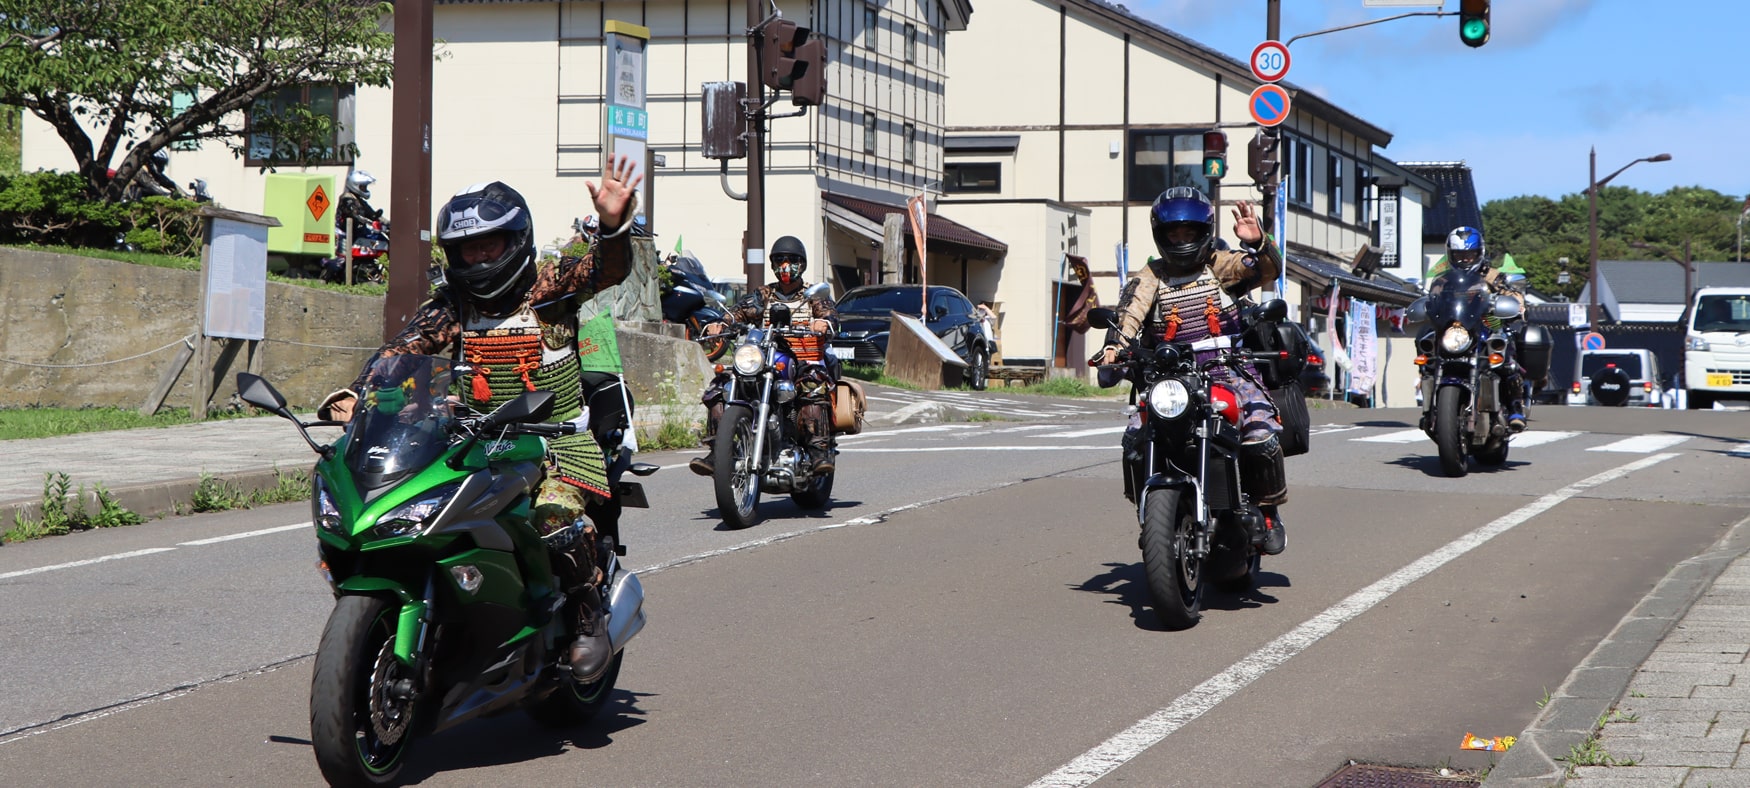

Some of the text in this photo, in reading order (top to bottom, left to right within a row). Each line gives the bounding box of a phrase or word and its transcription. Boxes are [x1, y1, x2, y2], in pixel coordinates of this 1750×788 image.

[1259, 52, 1282, 70] 30
[615, 108, 646, 129] 松前町
[1600, 382, 1620, 390] Jeep
[484, 440, 516, 456] Ninja
